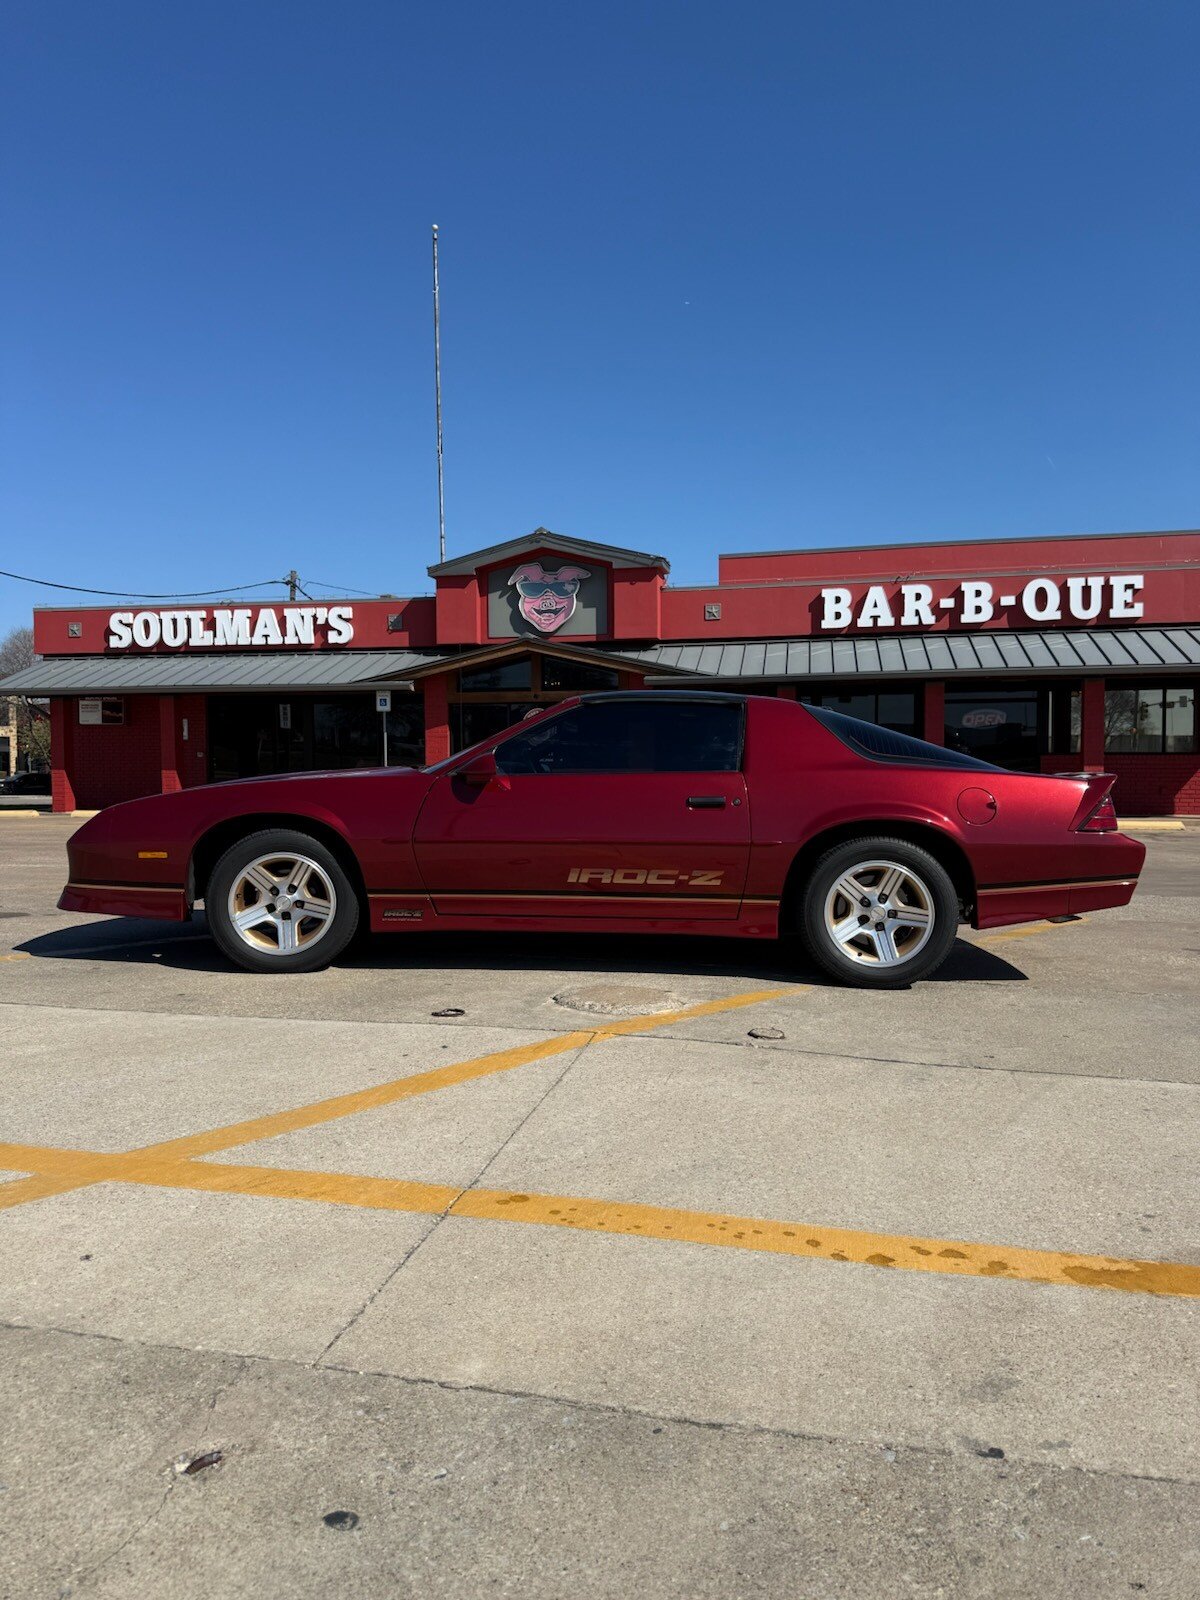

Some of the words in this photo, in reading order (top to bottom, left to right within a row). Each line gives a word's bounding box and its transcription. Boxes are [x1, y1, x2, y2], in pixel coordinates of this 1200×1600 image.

[820, 575, 1144, 628] BAR-B-QUE
[109, 607, 354, 648] SOULMAN'S
[962, 711, 1007, 725] OPEN
[567, 868, 724, 885] IROC-Z
